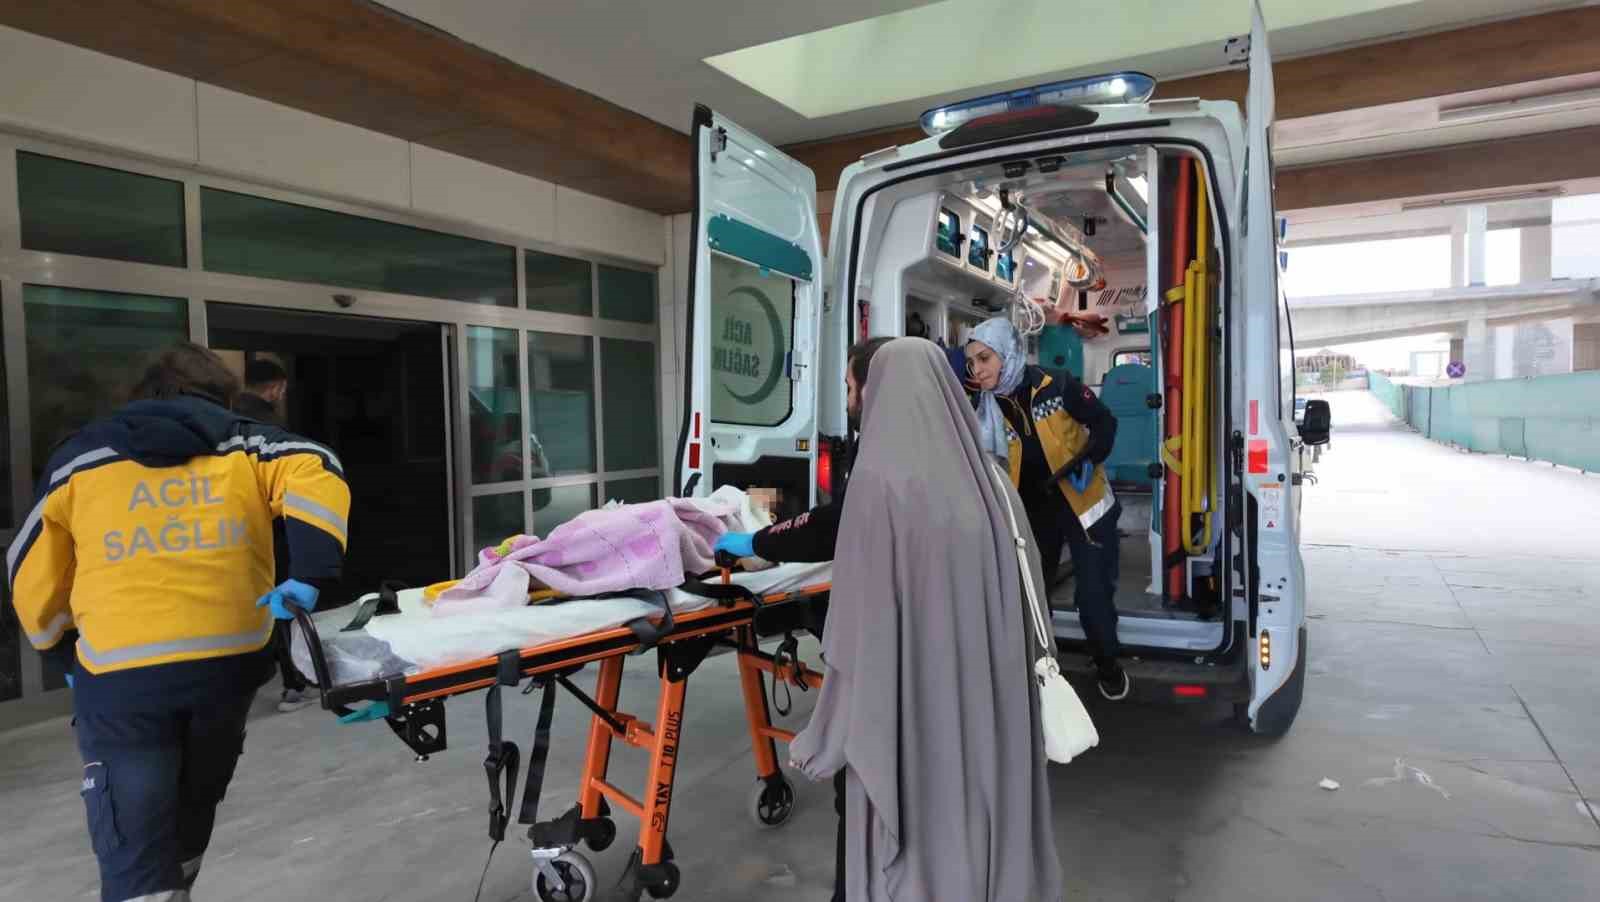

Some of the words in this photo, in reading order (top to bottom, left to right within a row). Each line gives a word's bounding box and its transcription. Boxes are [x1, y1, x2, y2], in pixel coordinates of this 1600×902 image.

[128, 472, 225, 512] ACİL
[655, 783, 670, 807] TAY
[665, 711, 681, 741] PLUS
